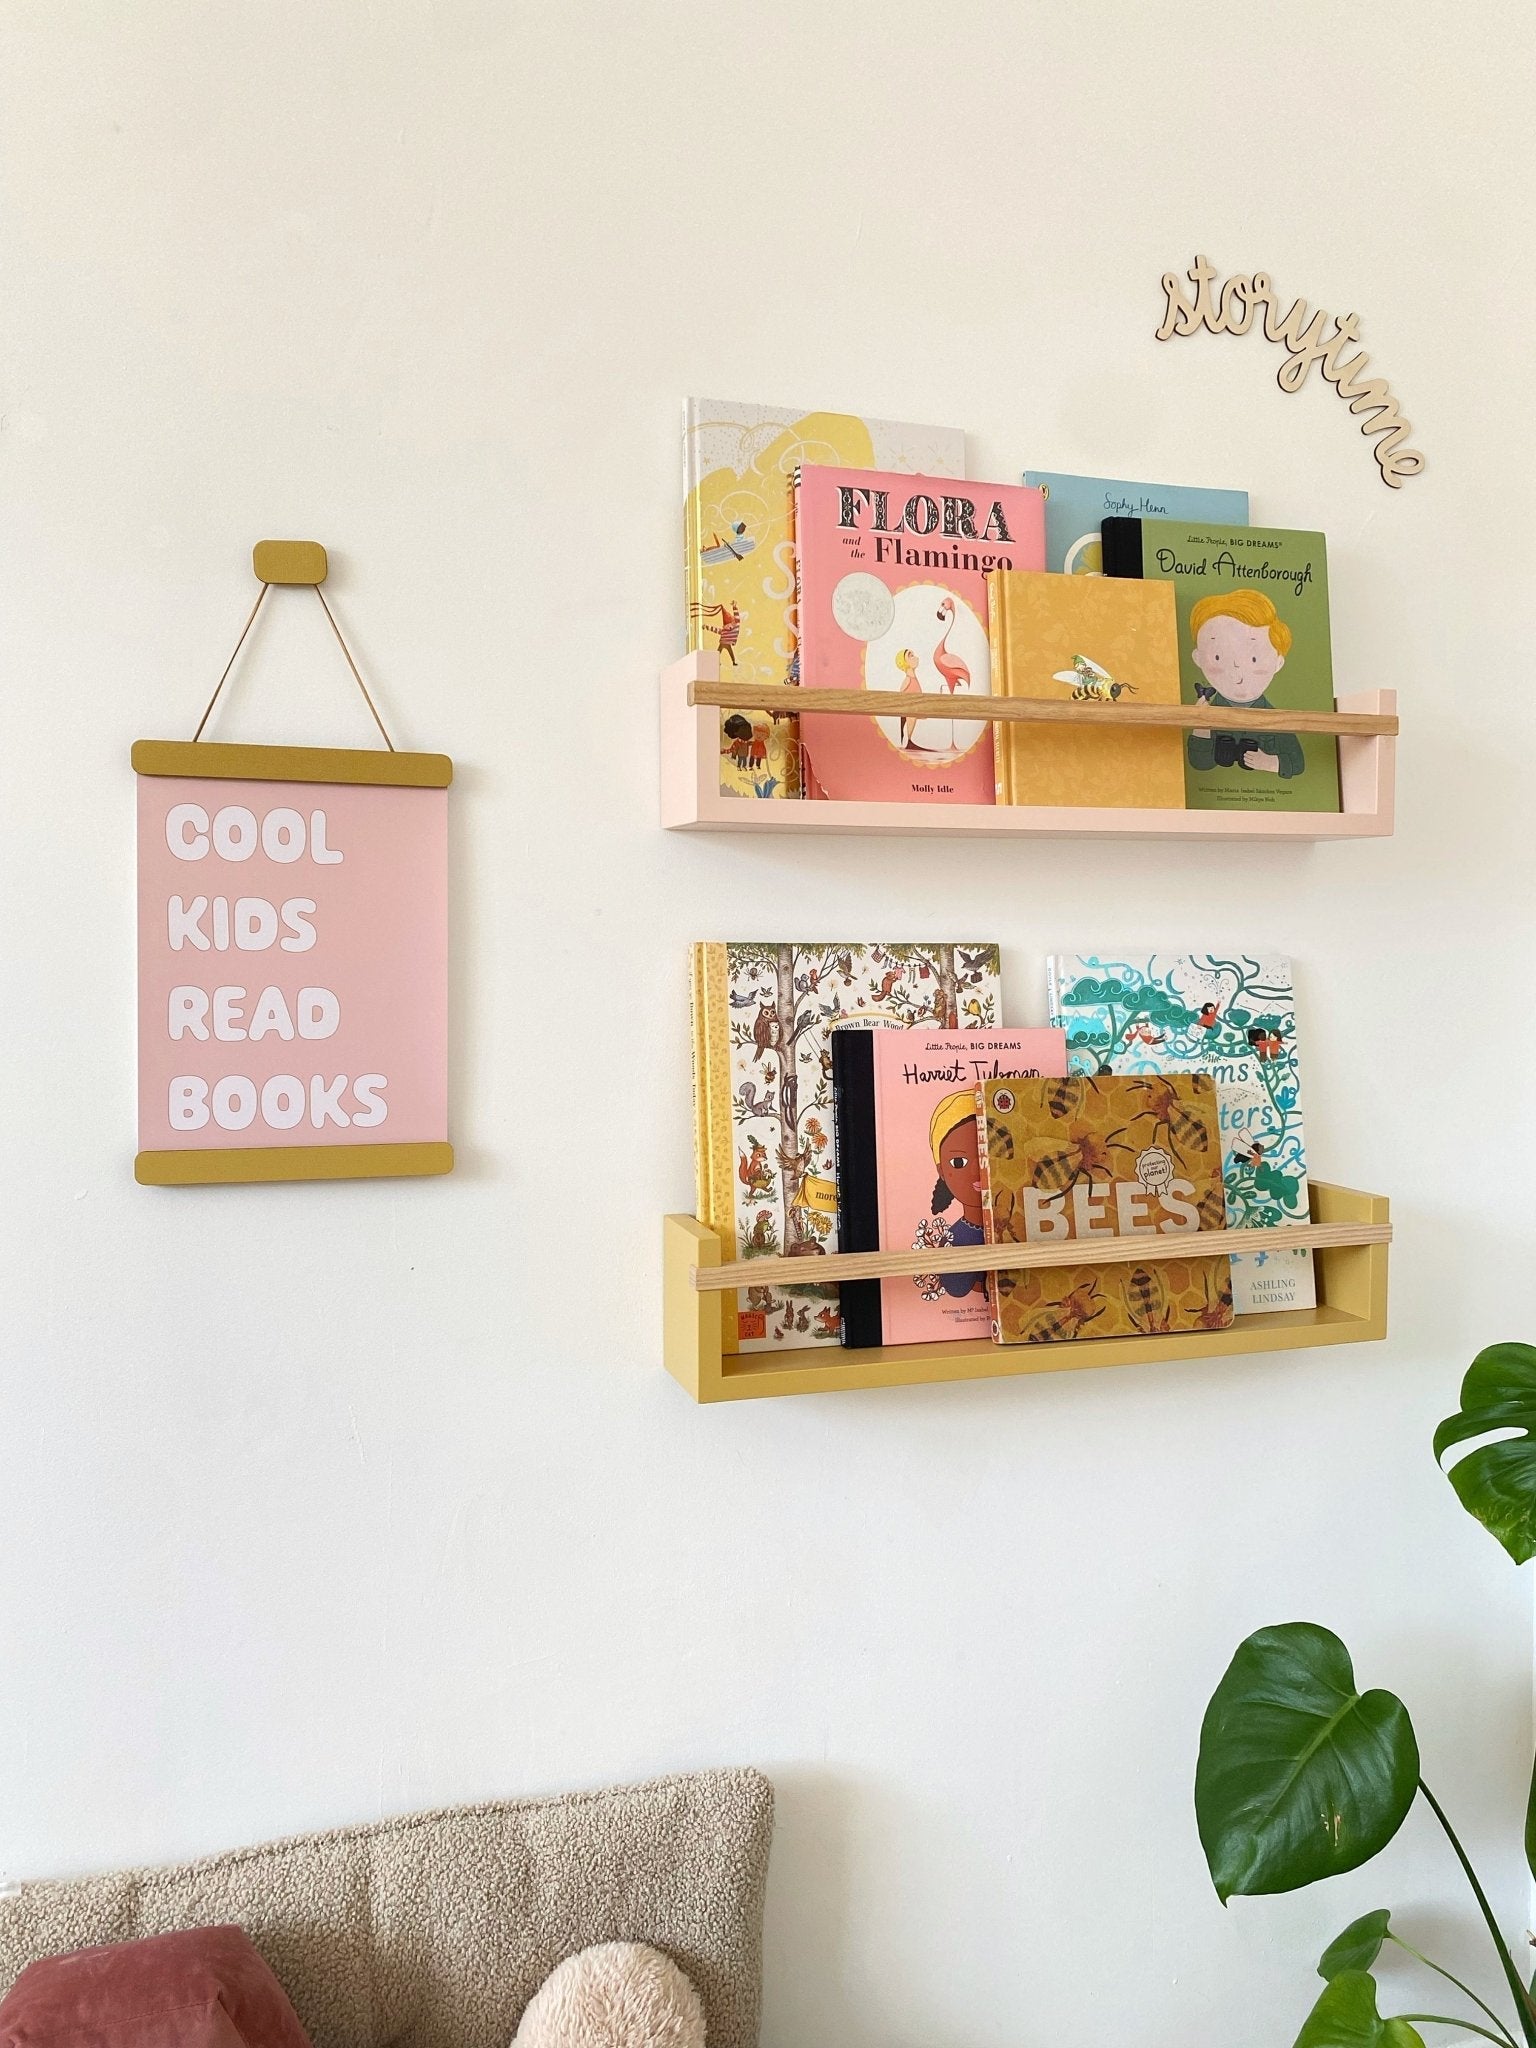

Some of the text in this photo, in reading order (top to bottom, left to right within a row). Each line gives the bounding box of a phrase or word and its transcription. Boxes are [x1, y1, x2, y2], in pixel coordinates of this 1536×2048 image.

[1155, 254, 1425, 489] storytime
[836, 486, 1016, 544] FLORA
[1103, 492, 1169, 517] Sophy Henn
[842, 536, 861, 546] and
[850, 548, 866, 559] the
[1229, 538, 1244, 547] BIG
[873, 537, 1013, 580] Flamingo
[1156, 548, 1313, 597] David Attenborough
[911, 784, 954, 795] Molly Idle
[165, 803, 344, 865] COOL
[167, 895, 318, 953] KIDS
[168, 985, 340, 1042] READ
[863, 1018, 879, 1027] Bear
[925, 1042, 944, 1051] Little
[970, 1042, 985, 1050] BIG
[987, 1042, 1022, 1050] DREAMS
[902, 1059, 967, 1084] Harriet
[168, 1073, 388, 1131] BOOKS
[976, 1114, 989, 1170] BEES
[1142, 1159, 1166, 1169] protecting
[1143, 1165, 1168, 1180] planet!
[1023, 1179, 1201, 1242] BEES
[1250, 1279, 1296, 1290] ASHLING
[1252, 1292, 1296, 1304] LINDSAY
